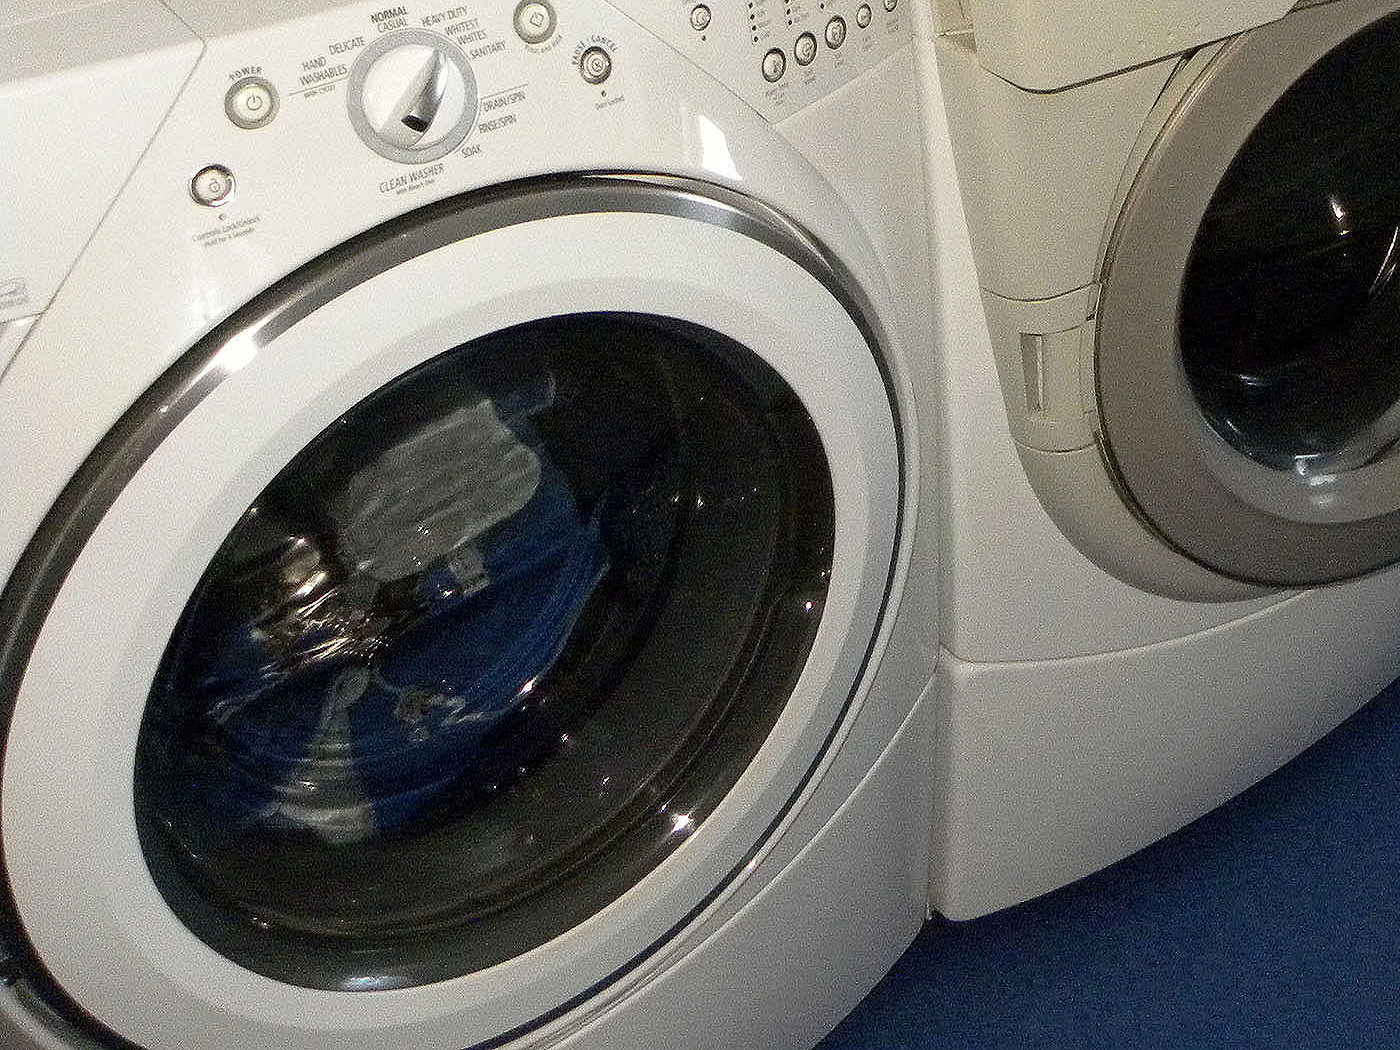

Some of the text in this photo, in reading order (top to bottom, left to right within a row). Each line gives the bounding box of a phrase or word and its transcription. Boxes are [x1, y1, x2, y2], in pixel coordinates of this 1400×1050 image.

[371, 6, 408, 24] NORMAL
[421, 6, 468, 27] HEAVY DUTY
[377, 17, 408, 33] CASUAL
[445, 18, 479, 36] WHITEST
[328, 36, 365, 55] DELICATE
[458, 30, 487, 46] WHITES
[469, 40, 506, 60] SANITARY
[229, 65, 262, 81] POWER
[303, 56, 327, 72] HAND
[300, 64, 348, 86] WASHABLES
[483, 92, 526, 112] DRAIN/SPIN
[462, 144, 482, 158] SOAK
[379, 175, 408, 193] CLEAN
[408, 163, 444, 182] WASHER
